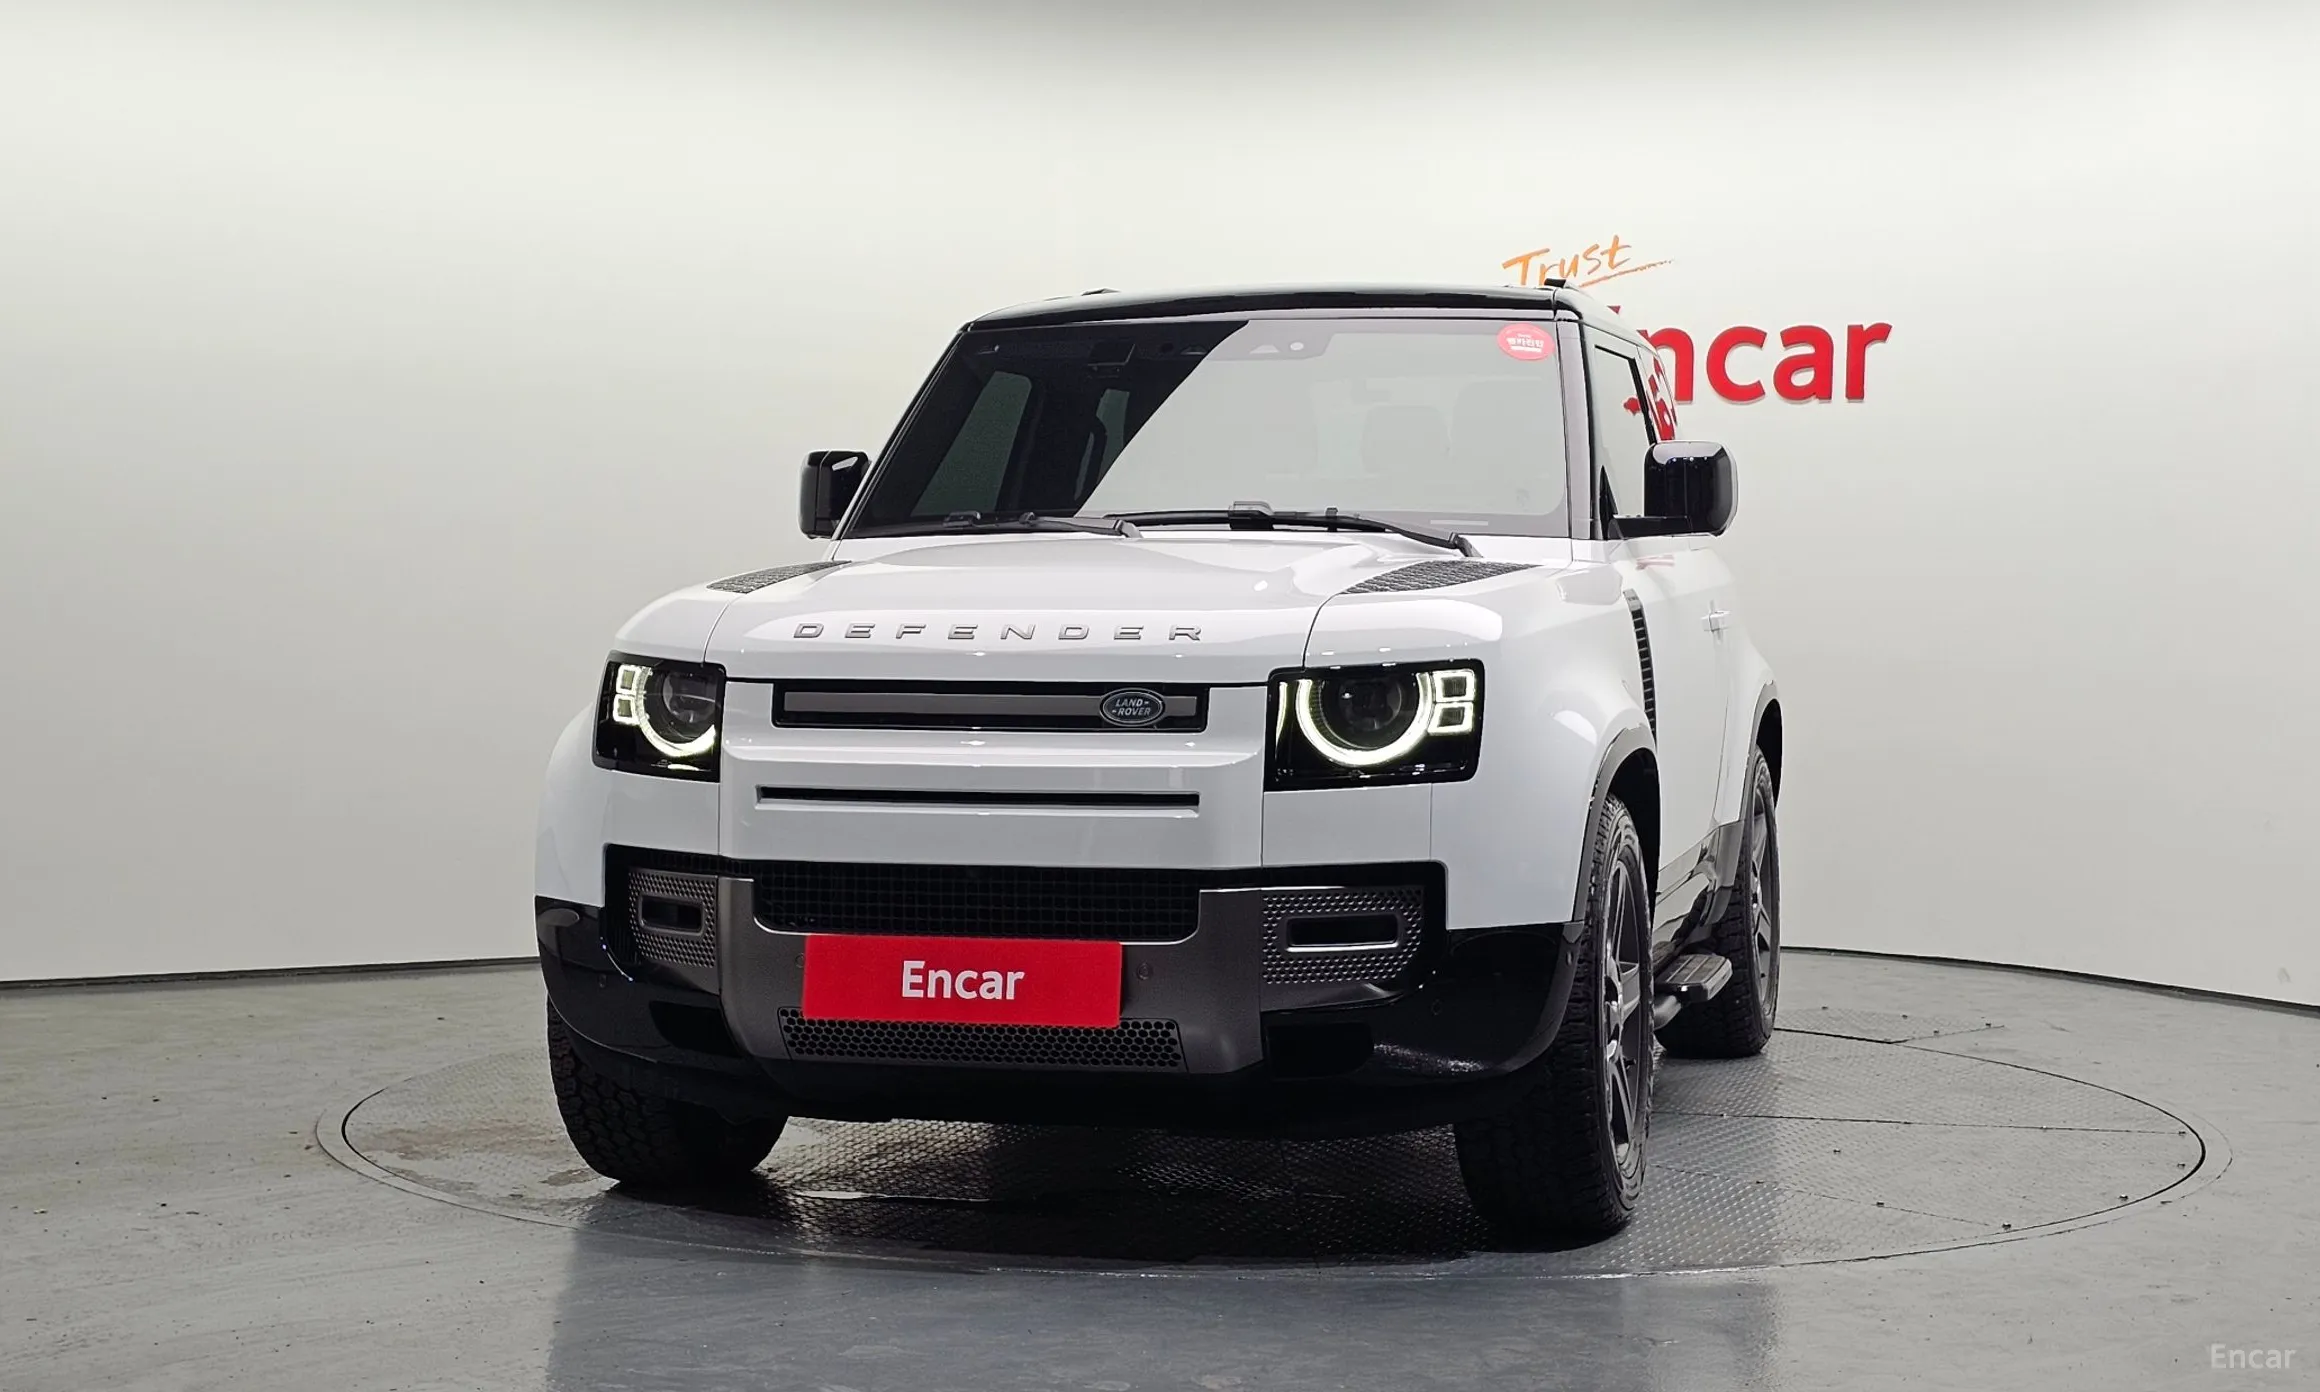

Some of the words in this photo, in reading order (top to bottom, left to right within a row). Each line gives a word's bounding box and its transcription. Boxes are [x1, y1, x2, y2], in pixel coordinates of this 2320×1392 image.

[1502, 234, 1632, 286] Trust
[1607, 304, 1893, 402] ncar
[793, 623, 1202, 641] DEFENDER
[901, 960, 1025, 1000] Encar
